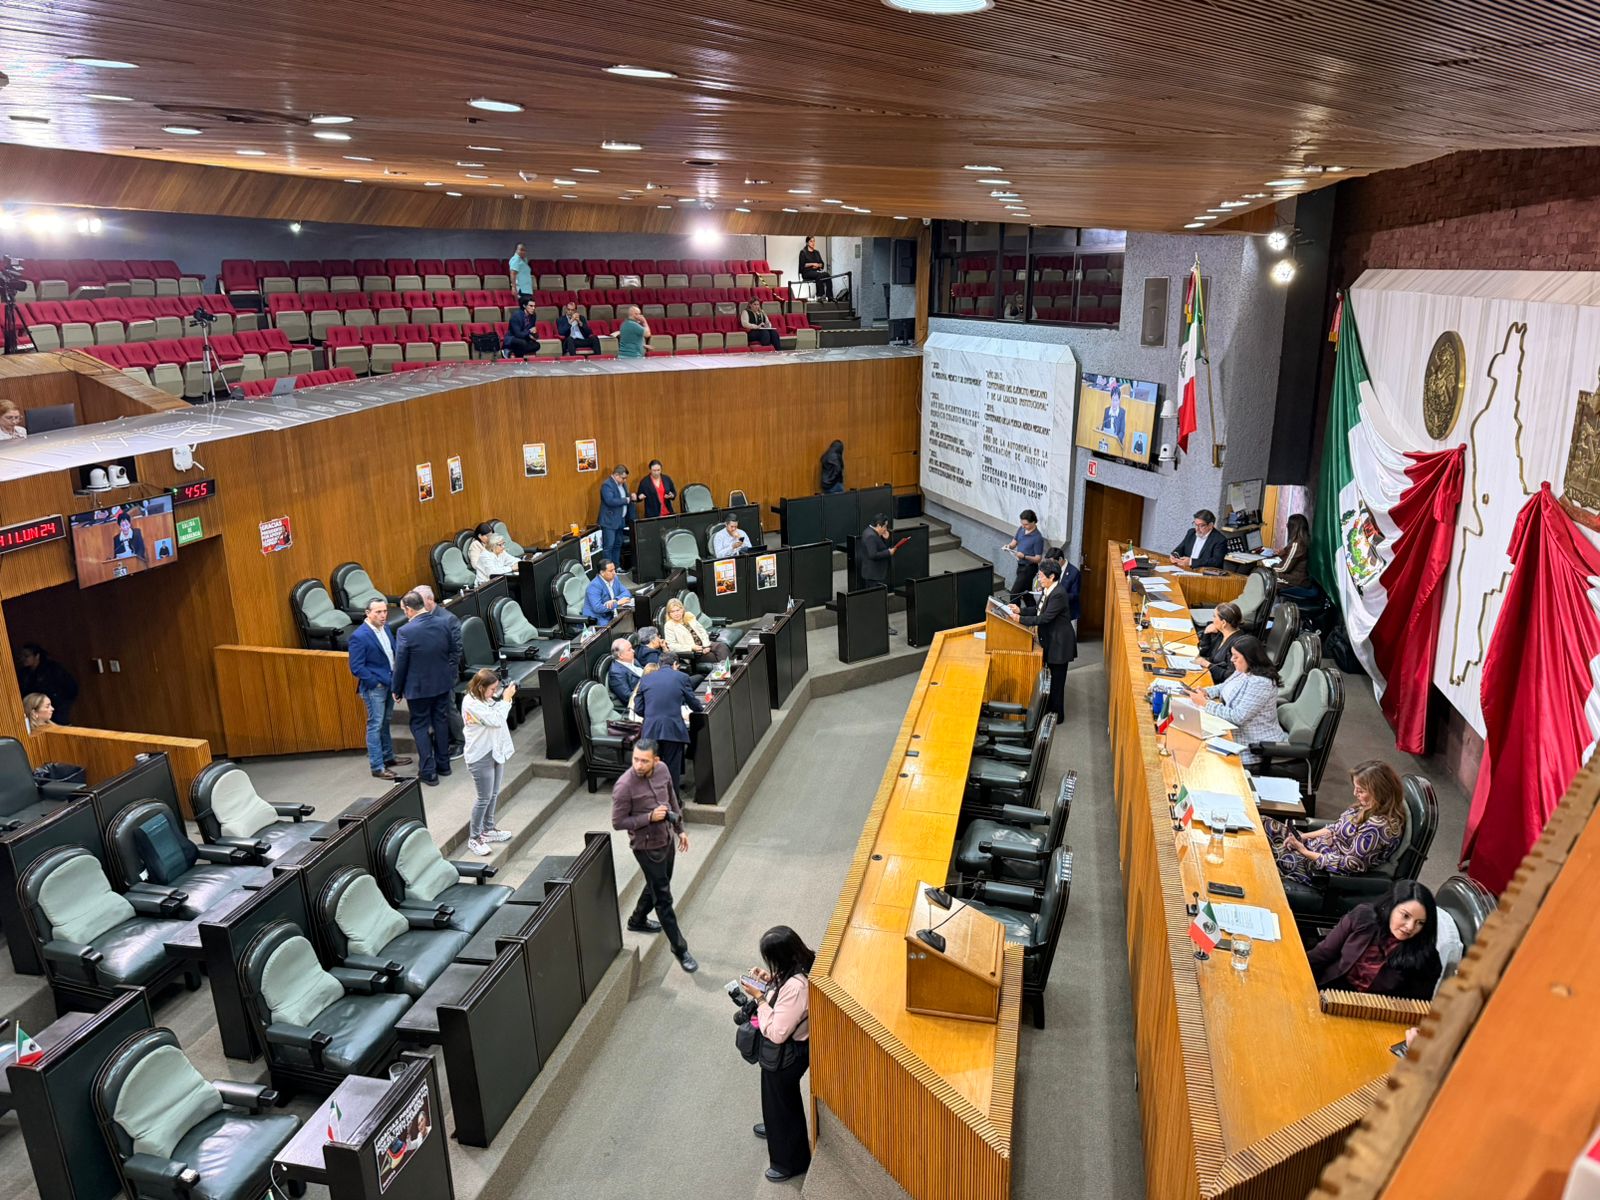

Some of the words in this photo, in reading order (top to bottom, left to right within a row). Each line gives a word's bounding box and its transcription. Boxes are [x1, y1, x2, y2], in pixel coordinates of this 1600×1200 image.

[993, 437, 998, 445] DE
[1007, 440, 1032, 454] AUTONOMÍA
[1034, 448, 1040, 456] EN
[1042, 450, 1048, 459] LA
[1015, 453, 1020, 462] DE
[982, 465, 1008, 479] CENTENARIO
[1009, 473, 1017, 483] DEL
[1018, 476, 1048, 492] PERIODISMO
[982, 474, 1000, 486] ESCRITO
[1002, 480, 1008, 488] EN
[1010, 482, 1026, 496] NUEVO
[15, 526, 38, 544] LUN
[40, 522, 56, 537] 24
